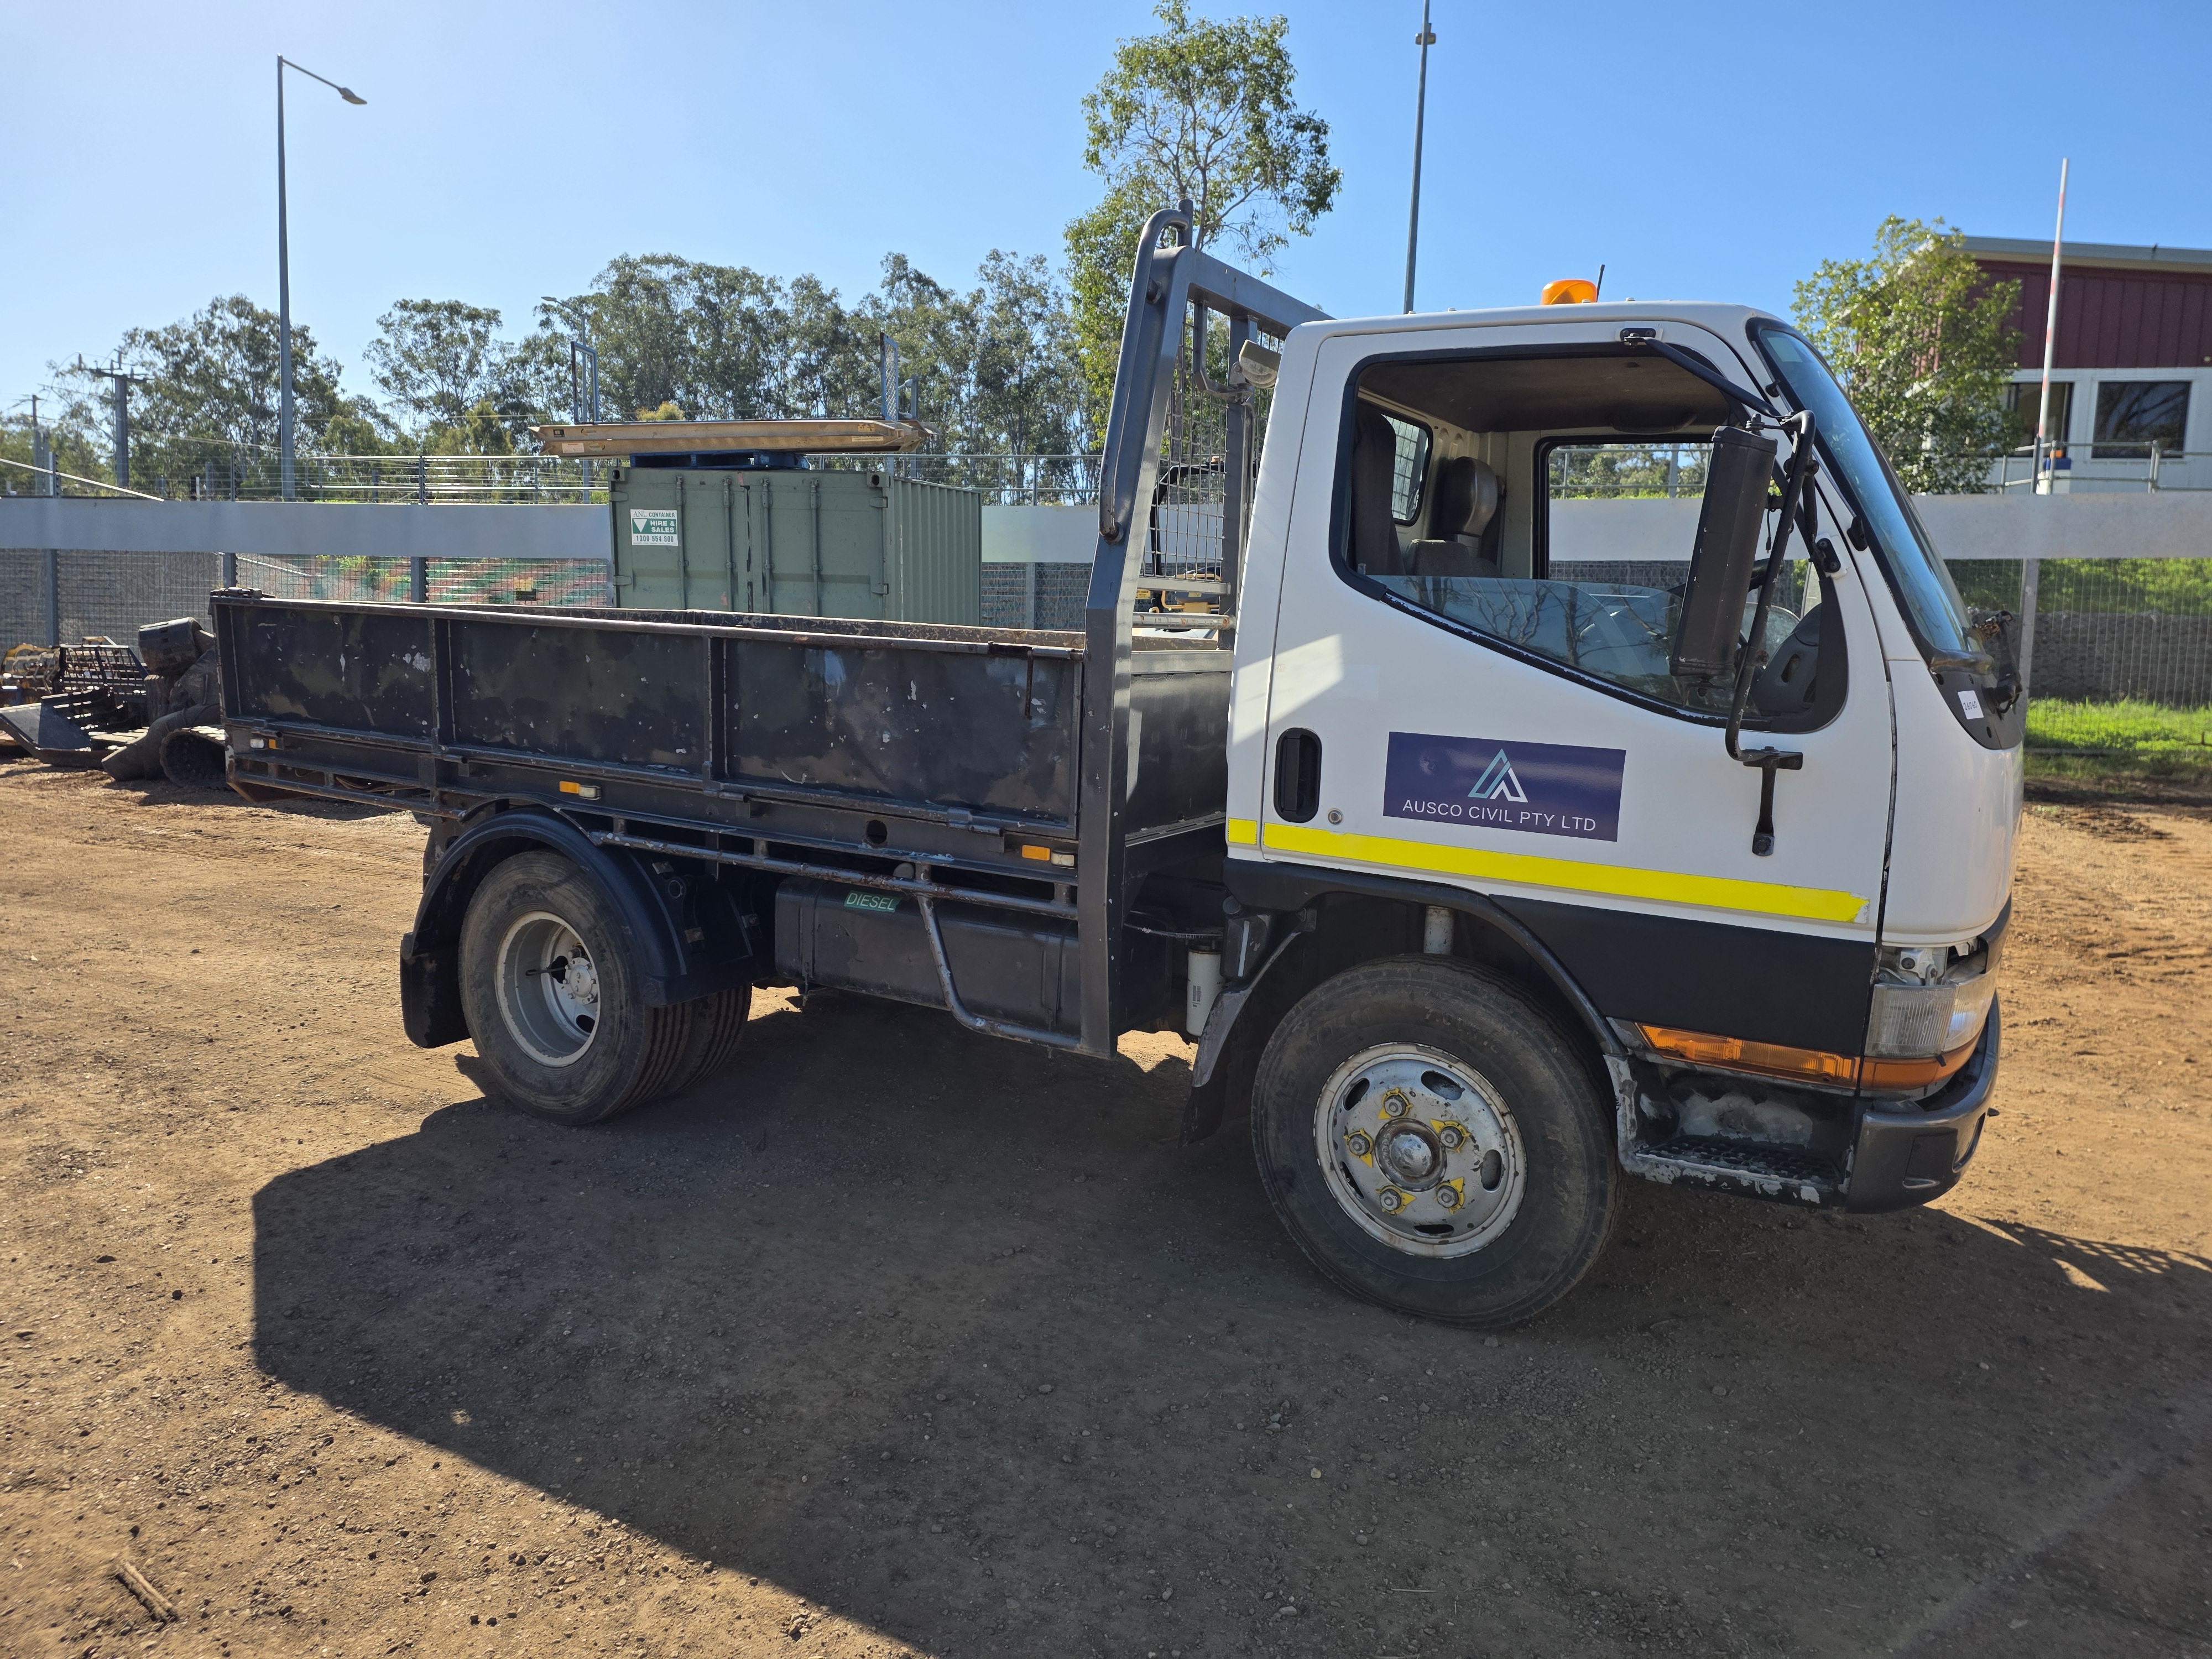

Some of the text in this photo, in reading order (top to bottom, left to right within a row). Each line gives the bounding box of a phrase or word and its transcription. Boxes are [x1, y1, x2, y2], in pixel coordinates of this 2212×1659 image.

[1402, 800, 1597, 831] AUSCO CIVIL PTY LTD
[846, 893, 894, 911] DIESEL
